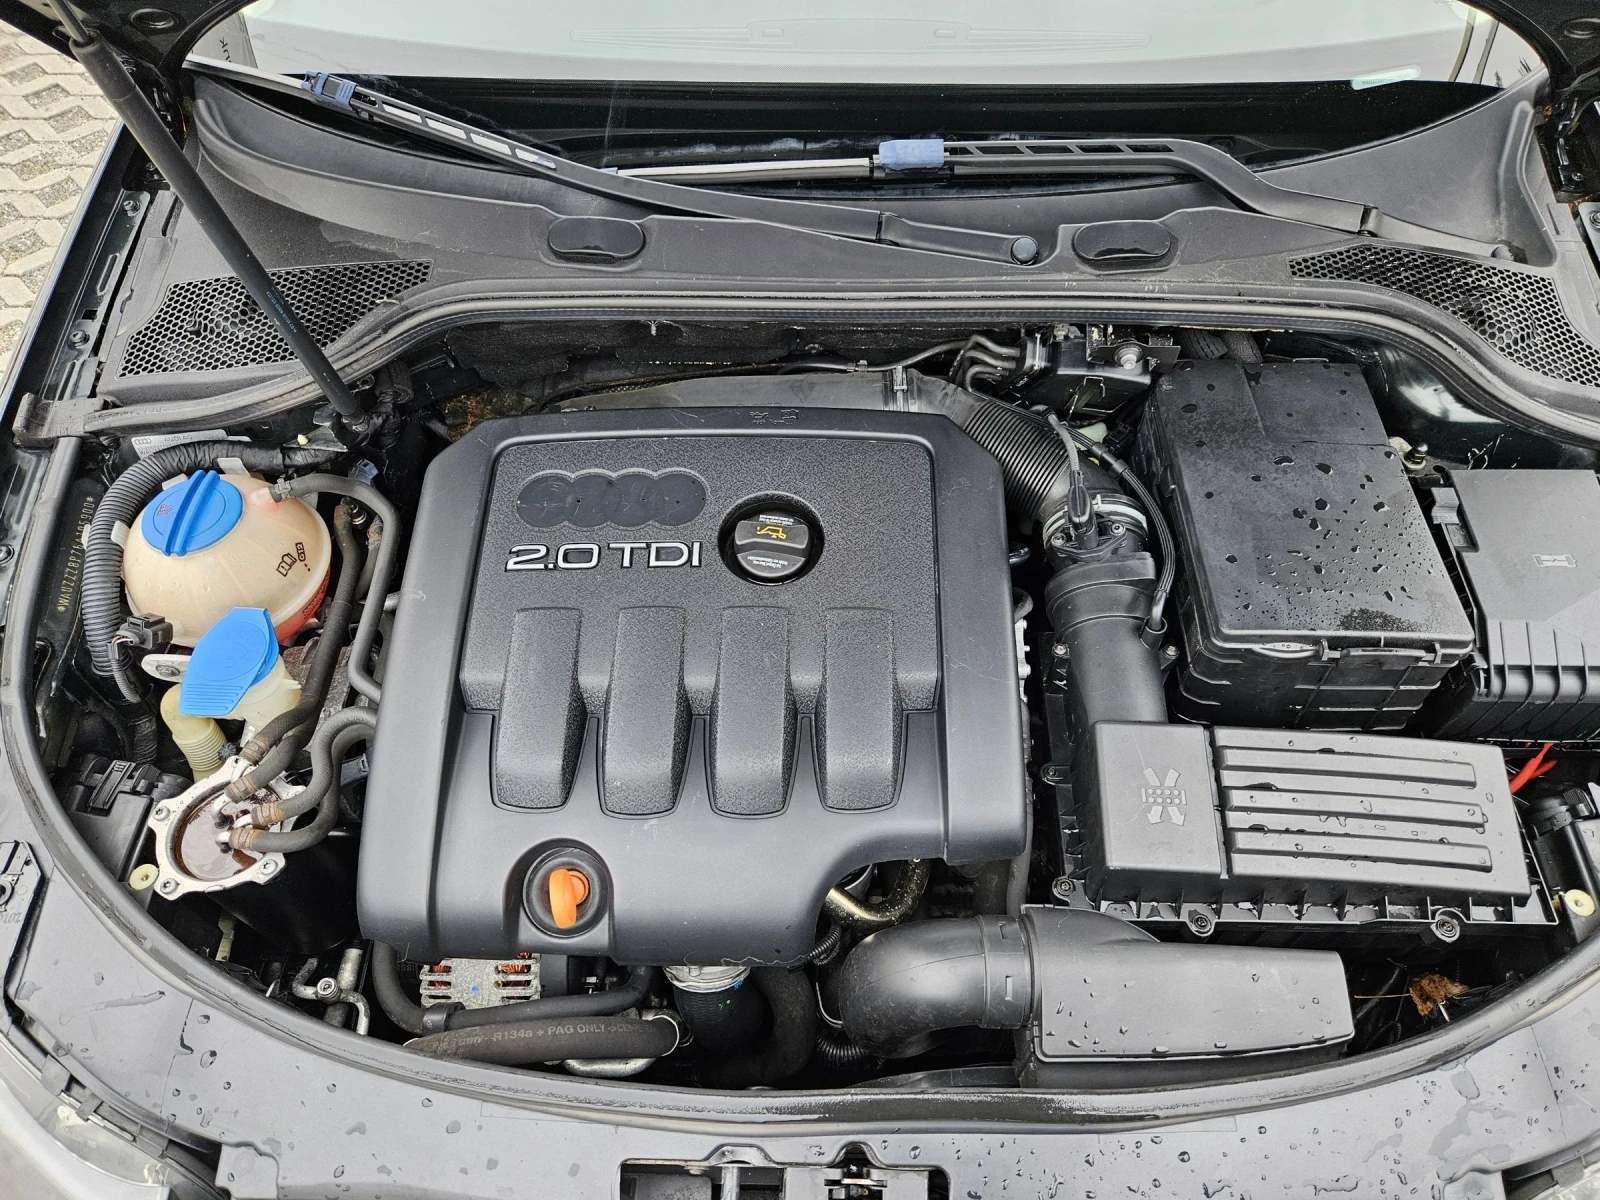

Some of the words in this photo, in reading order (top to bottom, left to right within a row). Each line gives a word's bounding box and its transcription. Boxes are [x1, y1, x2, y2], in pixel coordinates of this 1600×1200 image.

[505, 542, 601, 572] 2.0
[607, 540, 702, 569] TDI
[494, 1027, 533, 1042] R134a
[547, 1024, 574, 1036] PAG
[577, 1023, 605, 1034] ONLY
